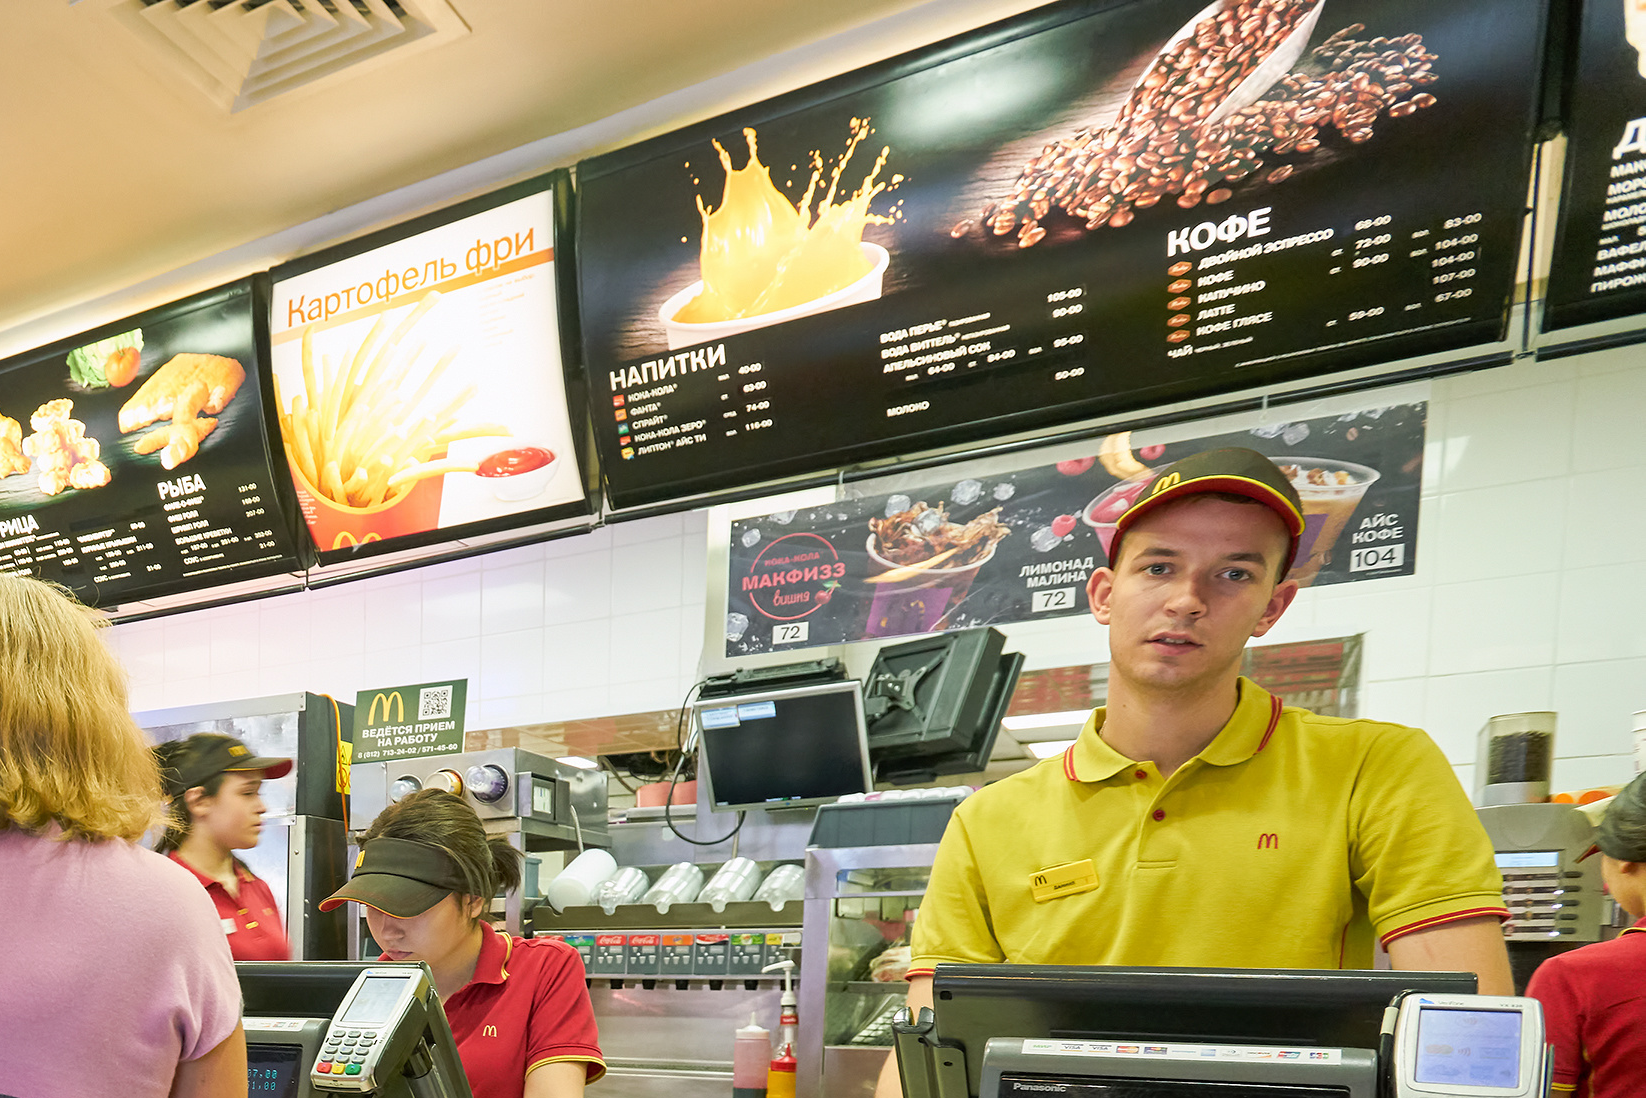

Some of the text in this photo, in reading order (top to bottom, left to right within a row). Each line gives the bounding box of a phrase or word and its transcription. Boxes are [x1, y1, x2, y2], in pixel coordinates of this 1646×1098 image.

[1167, 206, 1272, 257] КОФЕ
[1198, 243, 1263, 270] ДВОЙНОЙ
[1263, 228, 1335, 254] ЭСПРЕССО
[1197, 269, 1235, 287] КОФЕ
[1355, 233, 1392, 250] 72-00
[287, 255, 458, 328] Картофель
[465, 227, 535, 276] фри
[1432, 268, 1476, 285] 107-00
[1197, 280, 1267, 304] КАПУЧИНО
[1196, 303, 1236, 321] ЛАТТЕ
[1167, 344, 1193, 359] ЧАЙ
[1434, 288, 1473, 303] 67-00
[880, 328, 908, 344] ВОДА
[881, 343, 909, 359] ВОДА
[883, 341, 991, 374] АПЕЛЬСИНОВЫЙ СОК
[609, 343, 727, 391] НАПИТКИ
[886, 400, 930, 418] МОЛОКО
[675, 435, 694, 447] АЙС
[694, 433, 707, 443] ТИ
[157, 473, 207, 500] РЫБА
[1359, 513, 1399, 530] АЙС
[1352, 526, 1404, 544] КОФЕ
[764, 552, 821, 567] КОКА-КОЛА
[1018, 556, 1094, 578] ЛИМОНАД
[1354, 548, 1397, 568] 104
[742, 562, 846, 591] МАКФИЗЗ
[1026, 570, 1088, 588] МАЛИНА
[772, 589, 811, 607] вишня
[1042, 591, 1066, 608] 72
[781, 626, 801, 641] 72
[362, 721, 456, 739] ВЕДЁТСЯ ПРИЕМ
[377, 733, 438, 748] НА РАБОТУ
[363, 750, 380, 759] (812)
[1013, 1082, 1067, 1093] Panasonic
